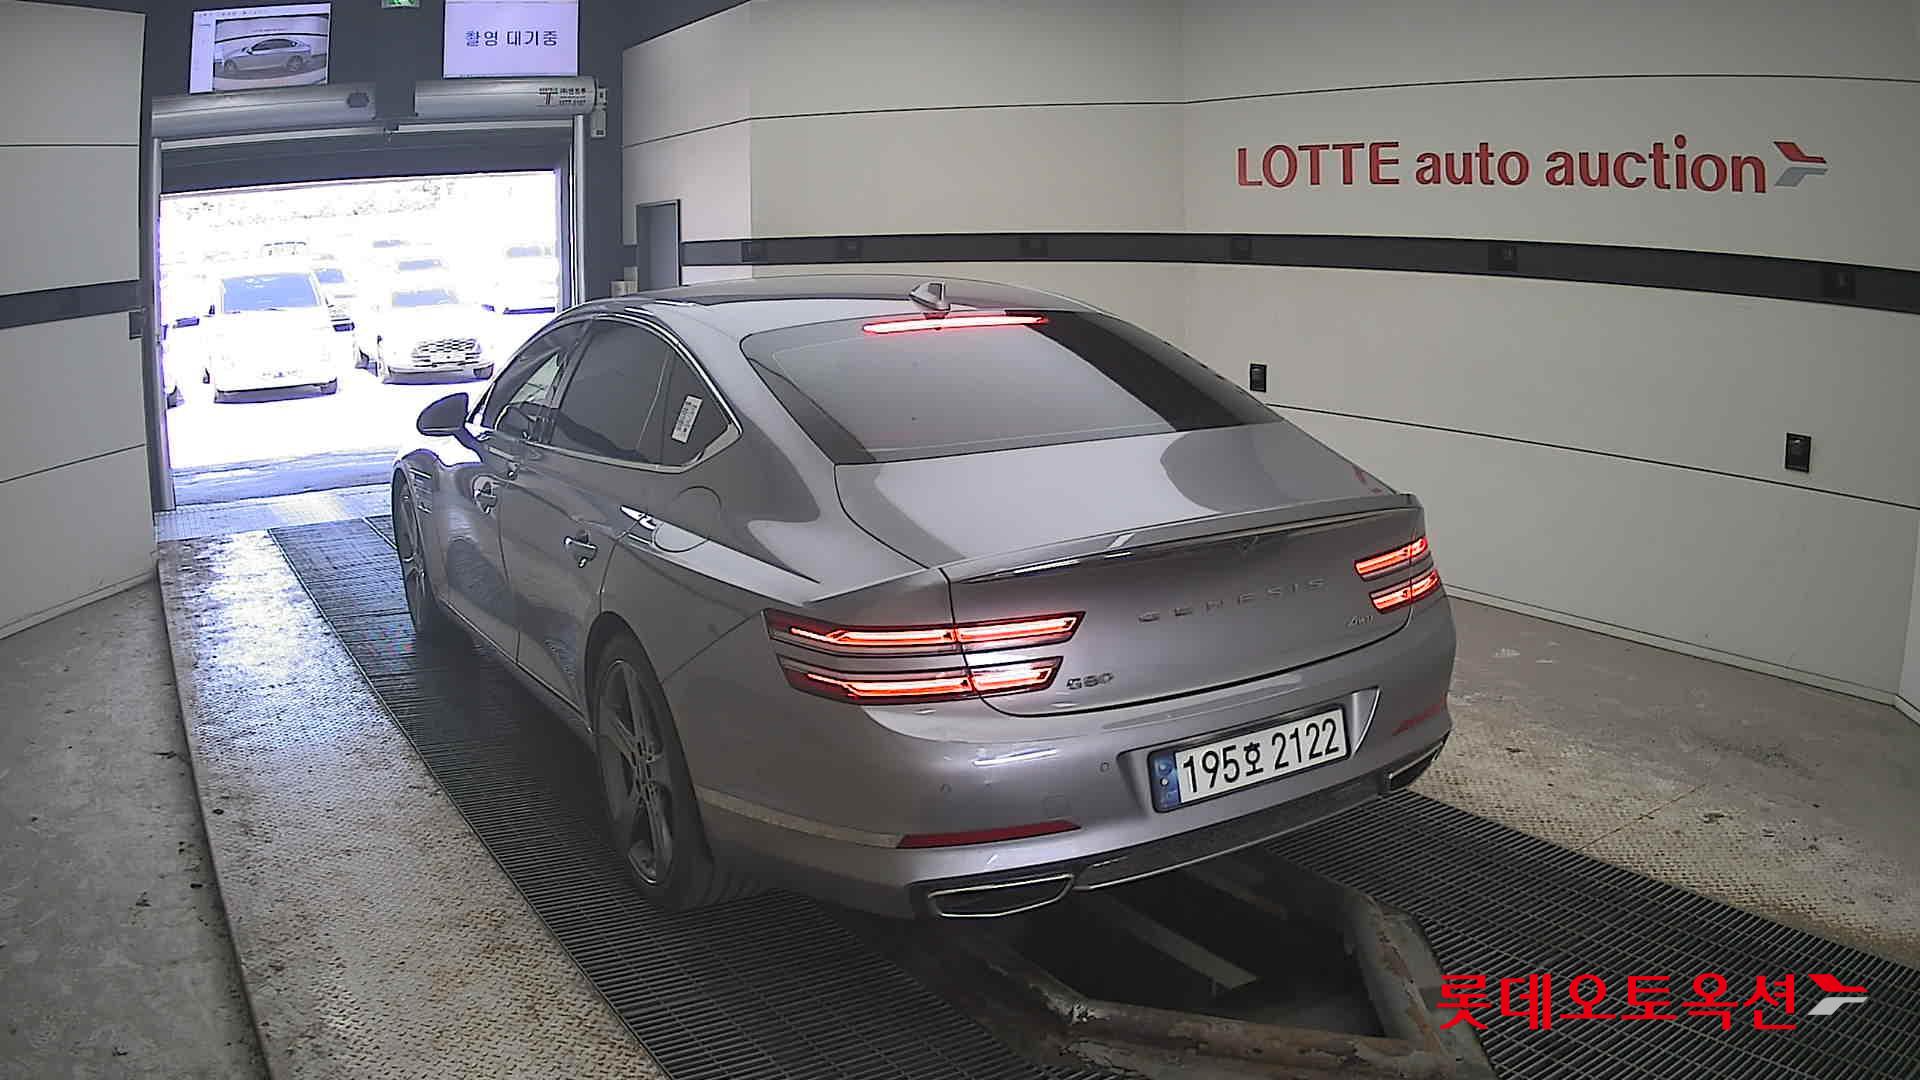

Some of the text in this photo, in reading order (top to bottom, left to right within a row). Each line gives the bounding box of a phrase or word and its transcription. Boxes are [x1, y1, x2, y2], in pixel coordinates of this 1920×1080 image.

[507, 30, 558, 47] 대기중
[1236, 135, 1766, 194] LOTTE auto auction
[1138, 577, 1326, 624] GENESIS
[1066, 672, 1115, 690] G80
[1183, 718, 1340, 793] 195호 2122
